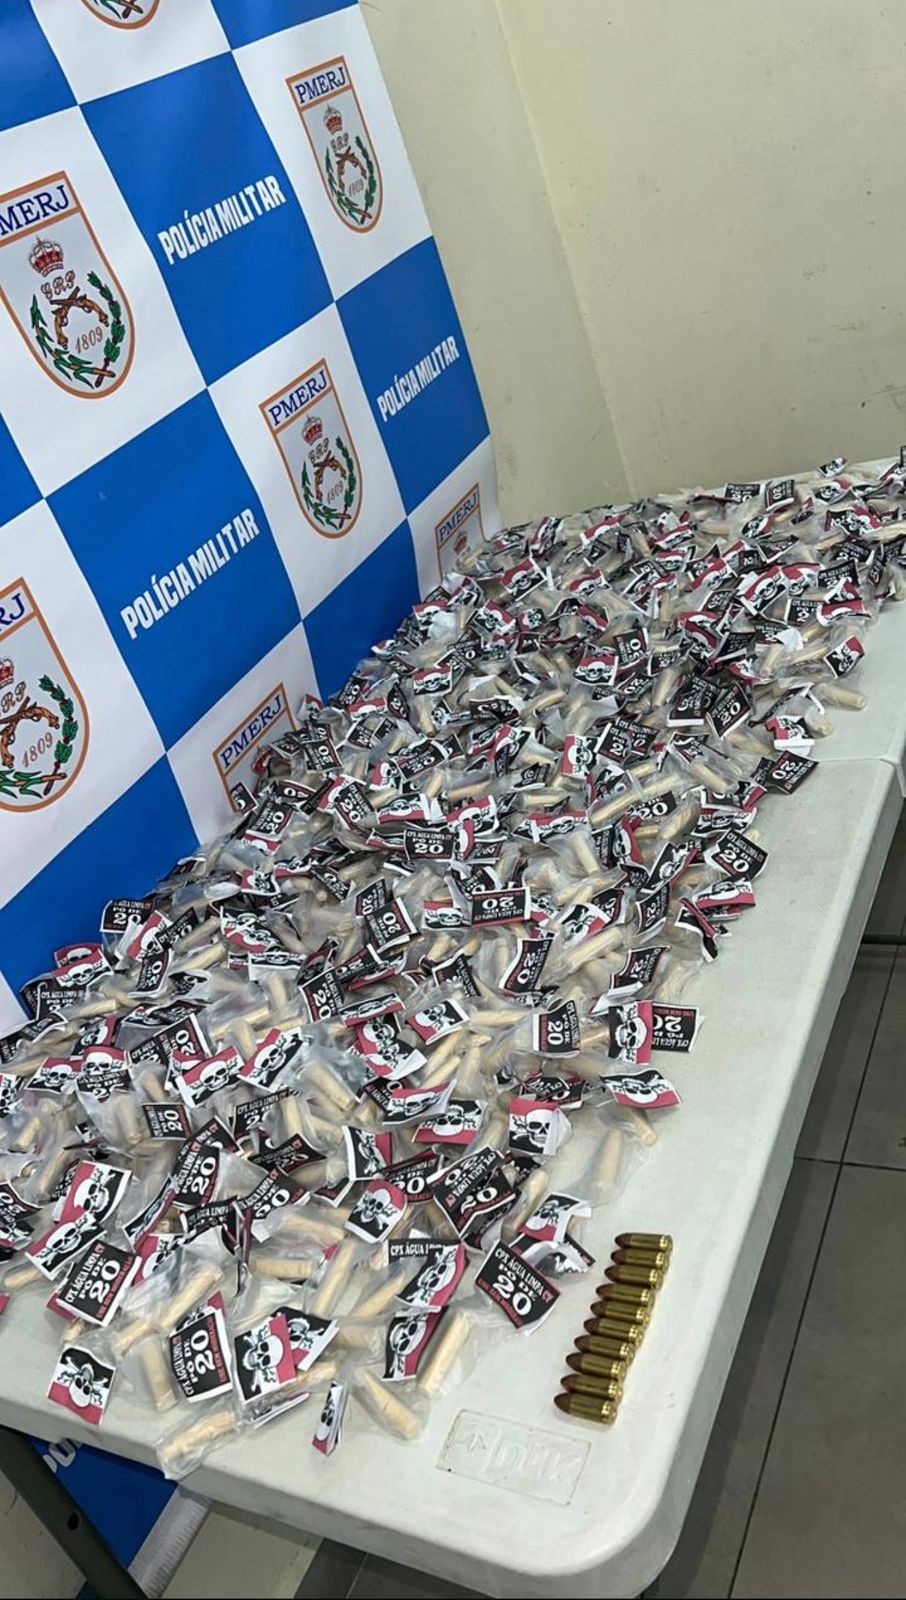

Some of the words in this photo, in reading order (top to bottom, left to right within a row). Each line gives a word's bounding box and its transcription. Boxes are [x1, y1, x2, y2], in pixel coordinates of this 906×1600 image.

[294, 66, 347, 105] PMERJ
[347, 178, 366, 197] 1809
[157, 209, 219, 265] POLÍCIA
[215, 174, 287, 243] MILITAR
[73, 326, 105, 354] 1809
[376, 370, 422, 422] POLÍCIA
[415, 335, 460, 394] MILITAR
[268, 370, 328, 427] PMERJ
[325, 480, 345, 504] 1809
[773, 487, 782, 499] 20
[437, 490, 479, 543] PMERJ
[119, 572, 196, 640] POLÍCIA
[186, 507, 261, 585] MILITAR
[719, 702, 740, 726] 20
[219, 696, 283, 771] PMERJ
[21, 732, 54, 768] 1809
[772, 760, 795, 779] 20
[267, 812, 284, 831] 20
[340, 798, 361, 823] 20
[638, 802, 668, 819] 20
[414, 843, 444, 853] 20
[719, 849, 750, 872] 20
[362, 894, 374, 915] 20
[482, 897, 514, 909] 20
[113, 912, 141, 924] 20
[382, 912, 401, 932] 20
[517, 953, 536, 984] 20
[313, 990, 331, 1021] 20
[176, 1030, 196, 1056] 20
[547, 1021, 564, 1045] 20
[164, 1110, 183, 1131] 20
[191, 1157, 216, 1196] 20
[256, 1189, 290, 1217] 20
[390, 1245, 406, 1257] CPX
[406, 1241, 426, 1256] ÁGUA
[82, 1253, 101, 1273] LIMPA
[91, 1257, 106, 1277] DE
[495, 1249, 510, 1263] CPX
[508, 1256, 526, 1279] ÁGUA
[525, 1273, 544, 1296] LIMPA
[70, 1271, 89, 1291] ÁGUA
[89, 1260, 121, 1303] 20
[518, 1281, 537, 1301] DE
[65, 1288, 78, 1303] CPX
[492, 1274, 532, 1315] 20
[184, 1339, 192, 1357] DE
[191, 1330, 216, 1375] 20
[182, 1380, 194, 1395] CPX
